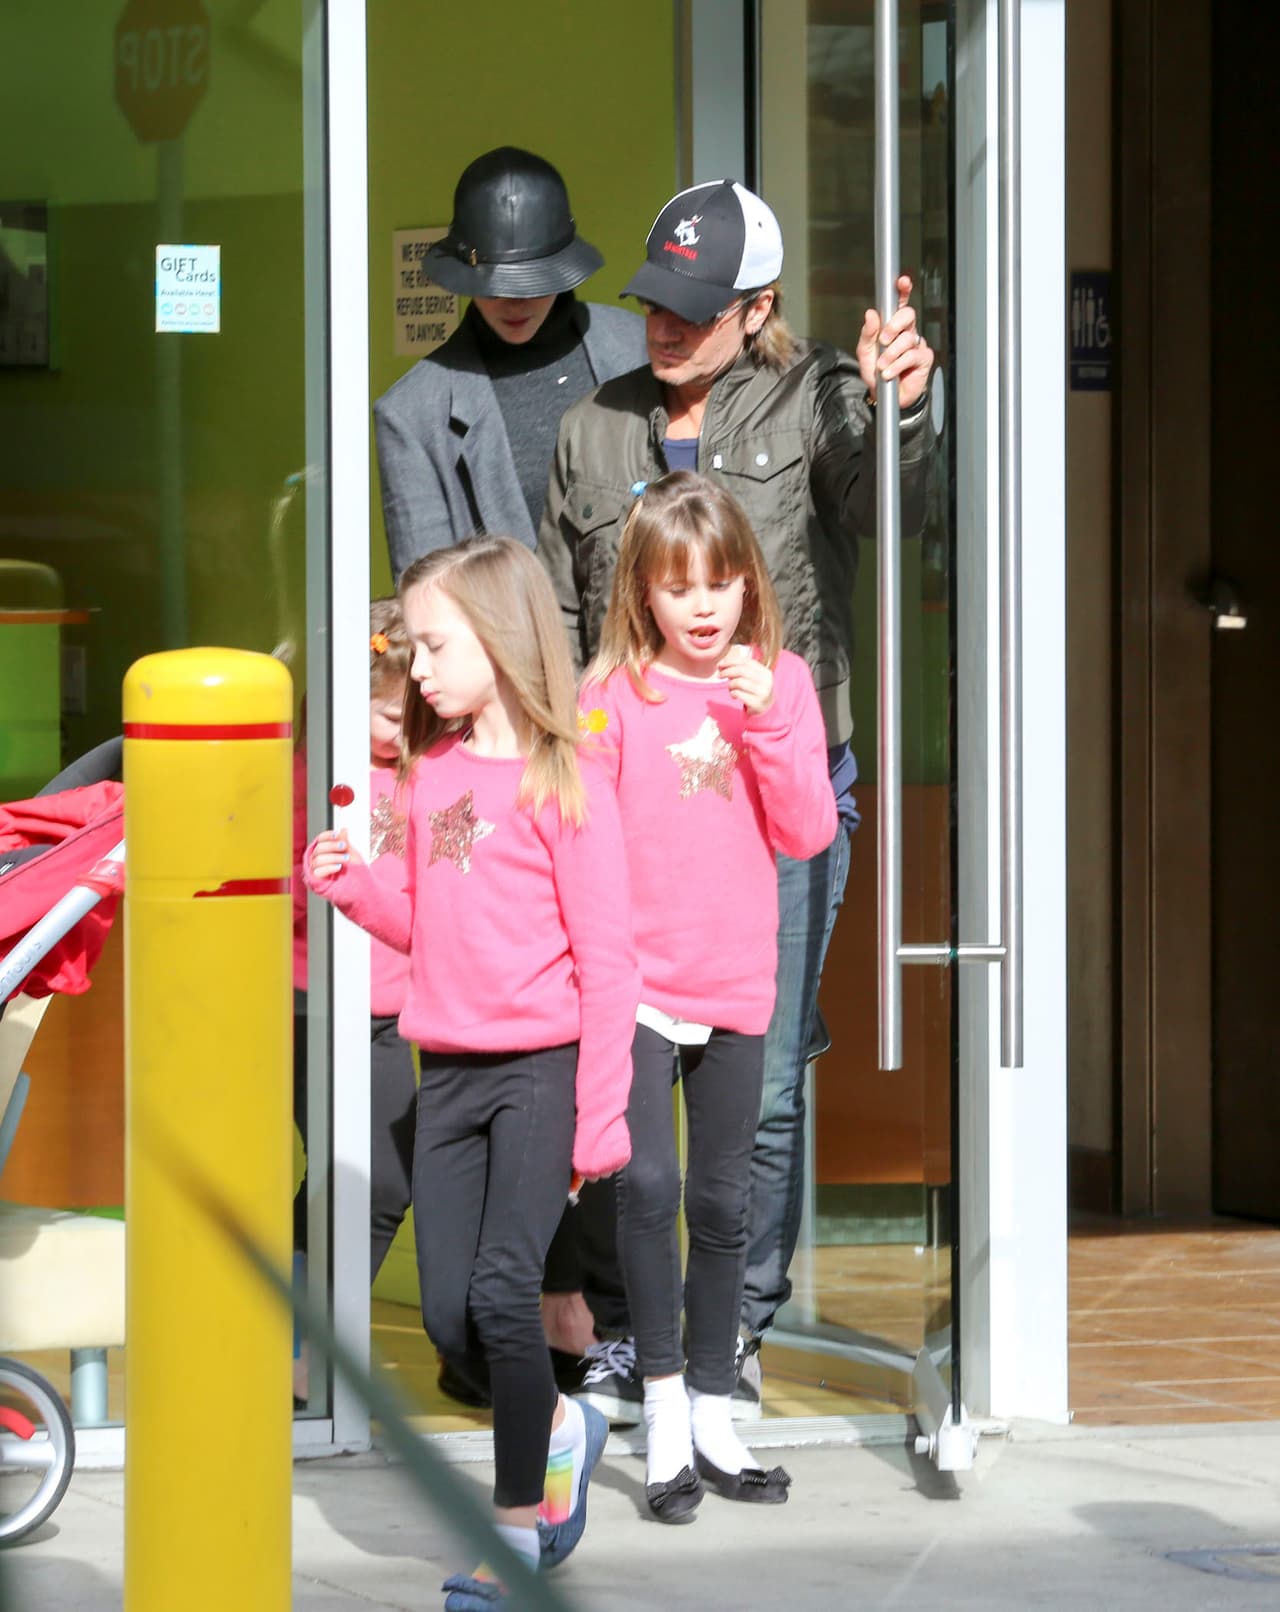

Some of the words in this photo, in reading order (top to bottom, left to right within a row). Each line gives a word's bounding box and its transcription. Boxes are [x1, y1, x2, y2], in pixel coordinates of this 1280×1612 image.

[402, 244, 413, 263] WE
[160, 257, 197, 272] GIFT
[175, 269, 216, 282] Cards
[401, 271, 415, 289] THE
[160, 289, 194, 297] Available
[397, 297, 424, 316] REFUSE
[425, 294, 455, 315] SERVICE
[406, 324, 415, 342] TO
[416, 323, 446, 342] ANYONE
